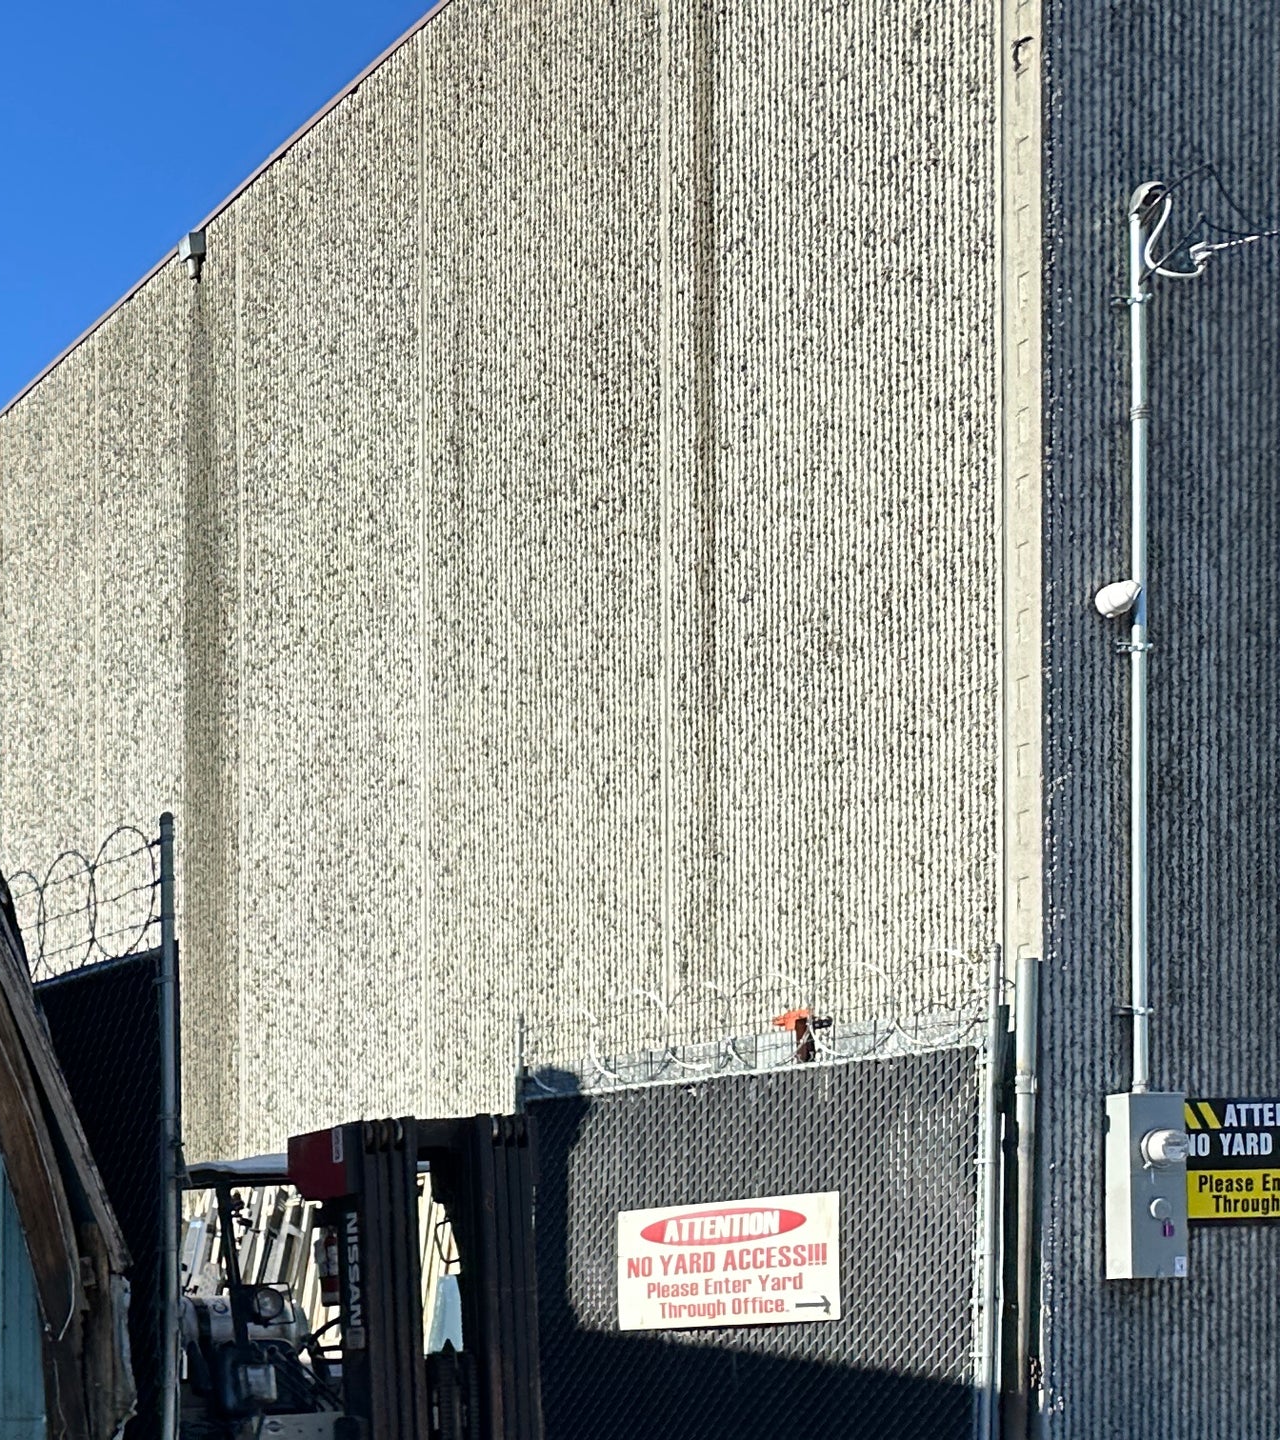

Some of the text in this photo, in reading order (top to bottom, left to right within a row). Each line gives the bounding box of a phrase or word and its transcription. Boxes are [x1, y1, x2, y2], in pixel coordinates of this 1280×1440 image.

[1223, 1103, 1280, 1127] ATTE
[1219, 1132, 1273, 1156] YARD
[1198, 1174, 1254, 1193] Please
[1212, 1194, 1280, 1215] Through
[662, 1210, 781, 1243] ATTENTION
[345, 1211, 365, 1327] NISSAN
[627, 1242, 828, 1279] NO YARD ACCESS!!!
[647, 1272, 804, 1299] Please Enter Yard
[658, 1298, 727, 1320] Through
